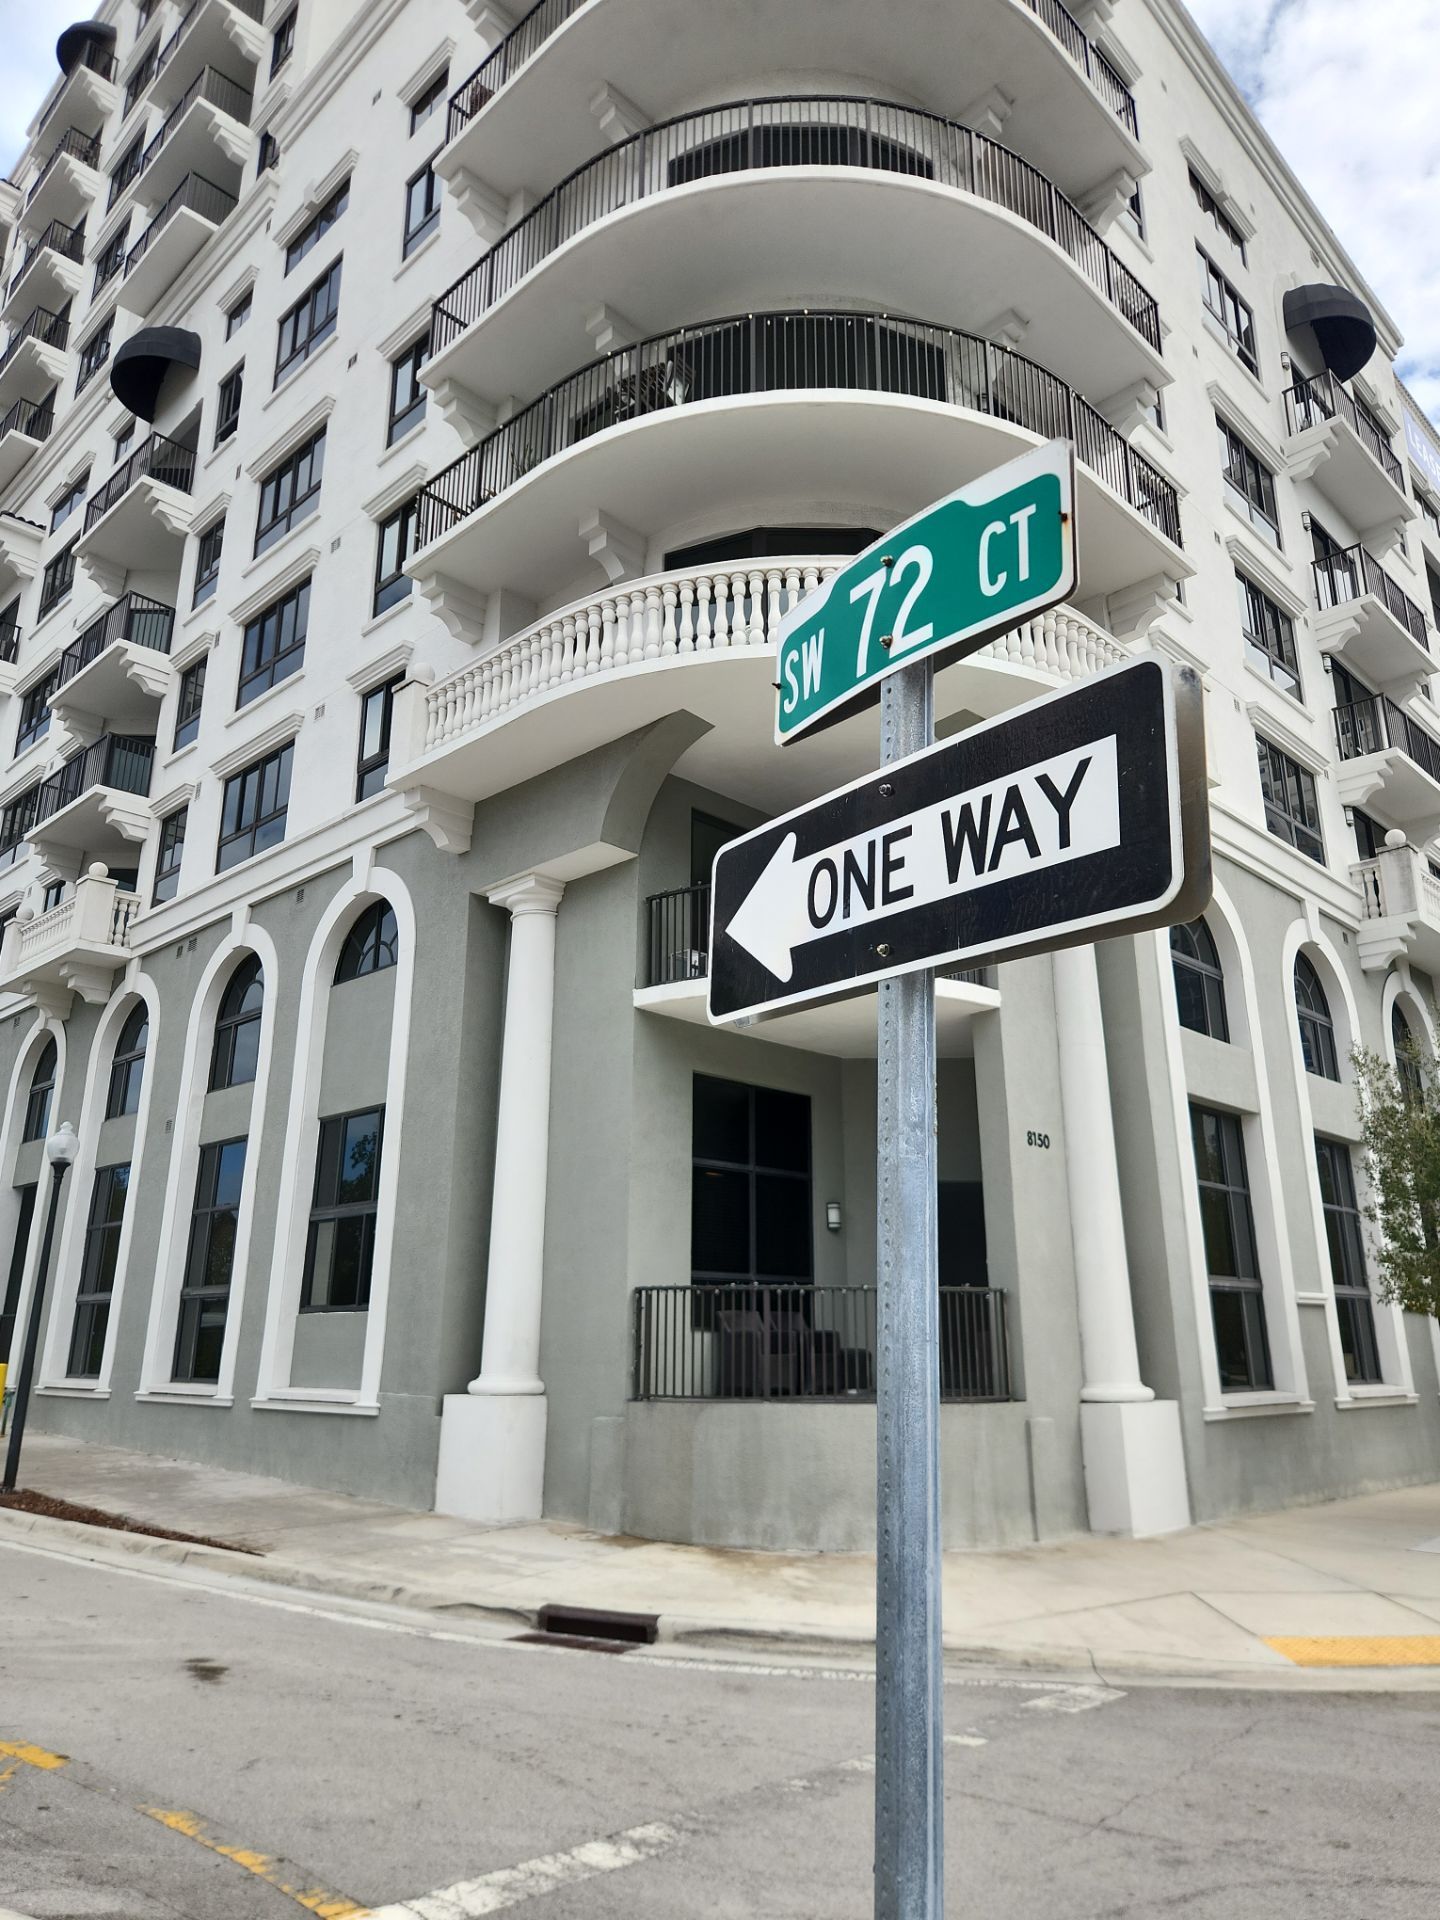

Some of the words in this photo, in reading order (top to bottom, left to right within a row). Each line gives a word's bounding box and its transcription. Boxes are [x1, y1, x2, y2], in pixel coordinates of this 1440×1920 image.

[784, 628, 825, 714] SW
[850, 545, 933, 678] 72
[979, 504, 1036, 597] CT
[808, 824, 914, 929] ONE
[941, 756, 1093, 884] WAY
[1027, 1130, 1050, 1149] 8150
